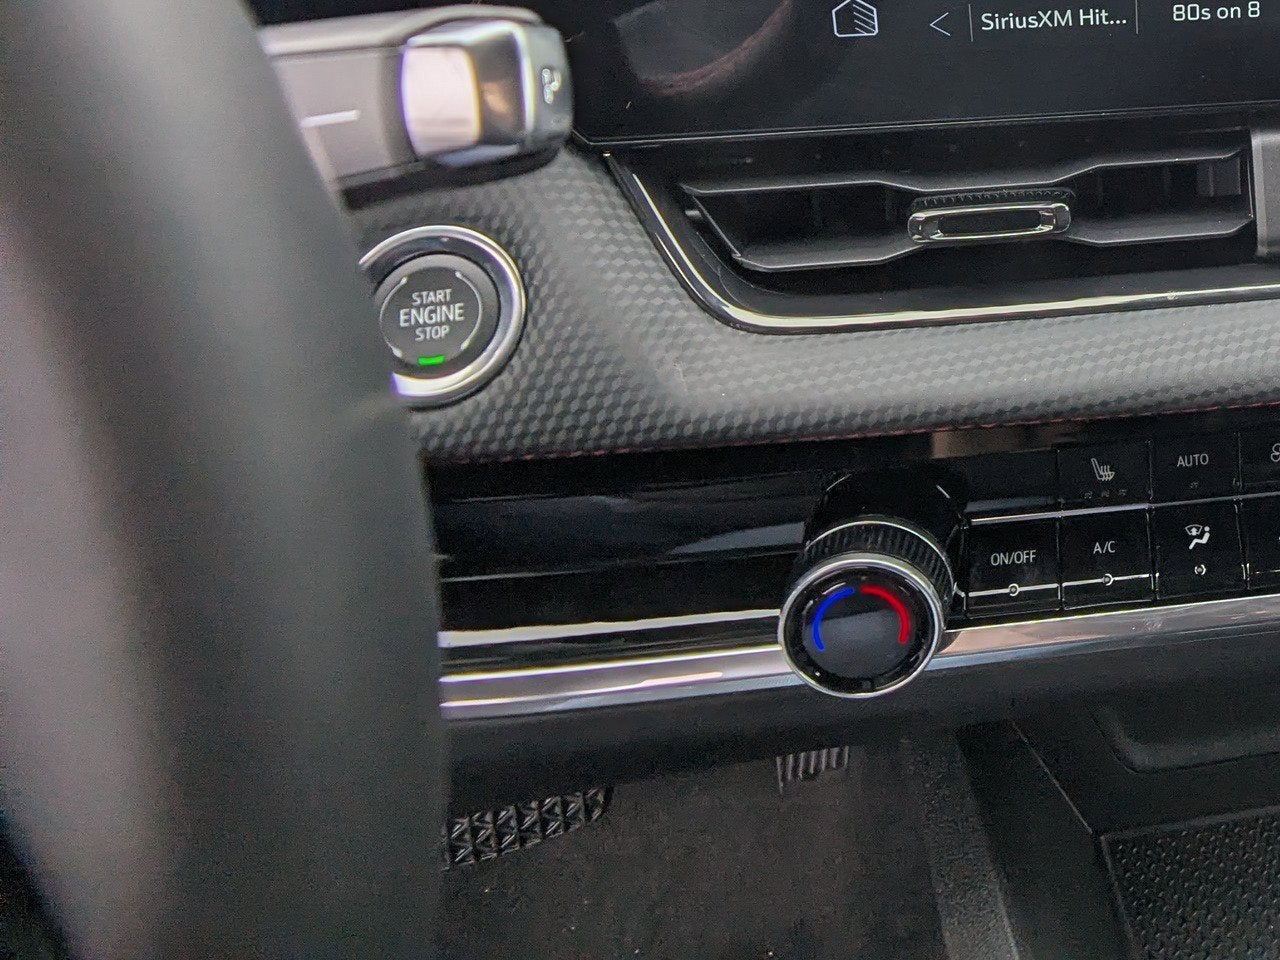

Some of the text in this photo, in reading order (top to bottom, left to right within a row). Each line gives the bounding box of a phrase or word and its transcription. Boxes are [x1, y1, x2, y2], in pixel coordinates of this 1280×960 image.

[981, 7, 1127, 32] SiriusXM Hit...
[1173, 1, 1261, 22] 80s on 8
[411, 289, 452, 306] START
[399, 303, 466, 327] ENGINE
[415, 325, 450, 341] STOP
[1177, 453, 1209, 468] AUTO
[1093, 540, 1116, 555] A/C
[990, 548, 1037, 566] ON/OFF
